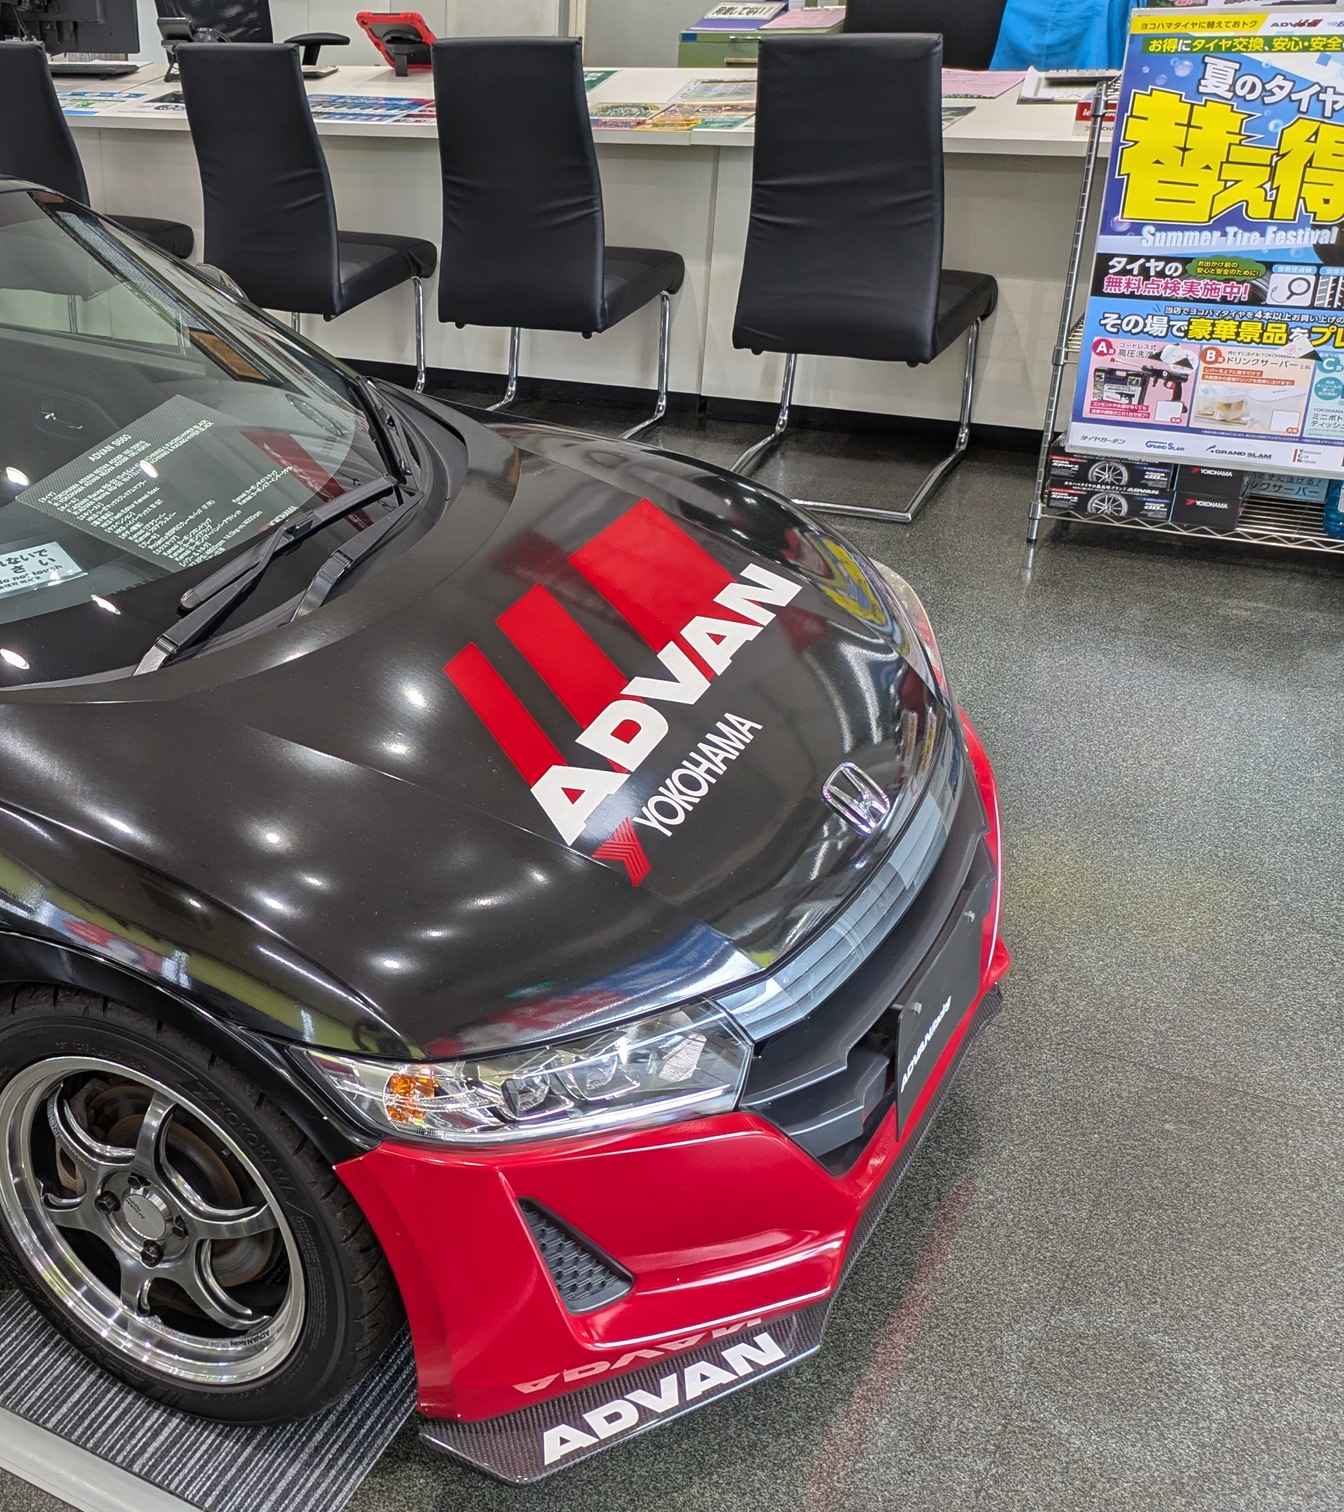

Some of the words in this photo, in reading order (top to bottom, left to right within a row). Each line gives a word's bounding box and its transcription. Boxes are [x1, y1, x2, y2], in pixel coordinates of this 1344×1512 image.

[1148, 36, 1344, 53] お得にタイヤ交換、安心・安全
[1141, 225, 1219, 248] Summer
[1225, 226, 1260, 247] Tire
[1264, 225, 1338, 247] Festival
[1107, 256, 1183, 277] タイヤの
[1102, 275, 1250, 301] 無料点検実施中!
[1227, 356, 1299, 369] ドリンクサーバー
[529, 563, 803, 847] ADVAN
[631, 711, 763, 838] YOKOHAMA
[543, 1330, 787, 1467] ADVAN
